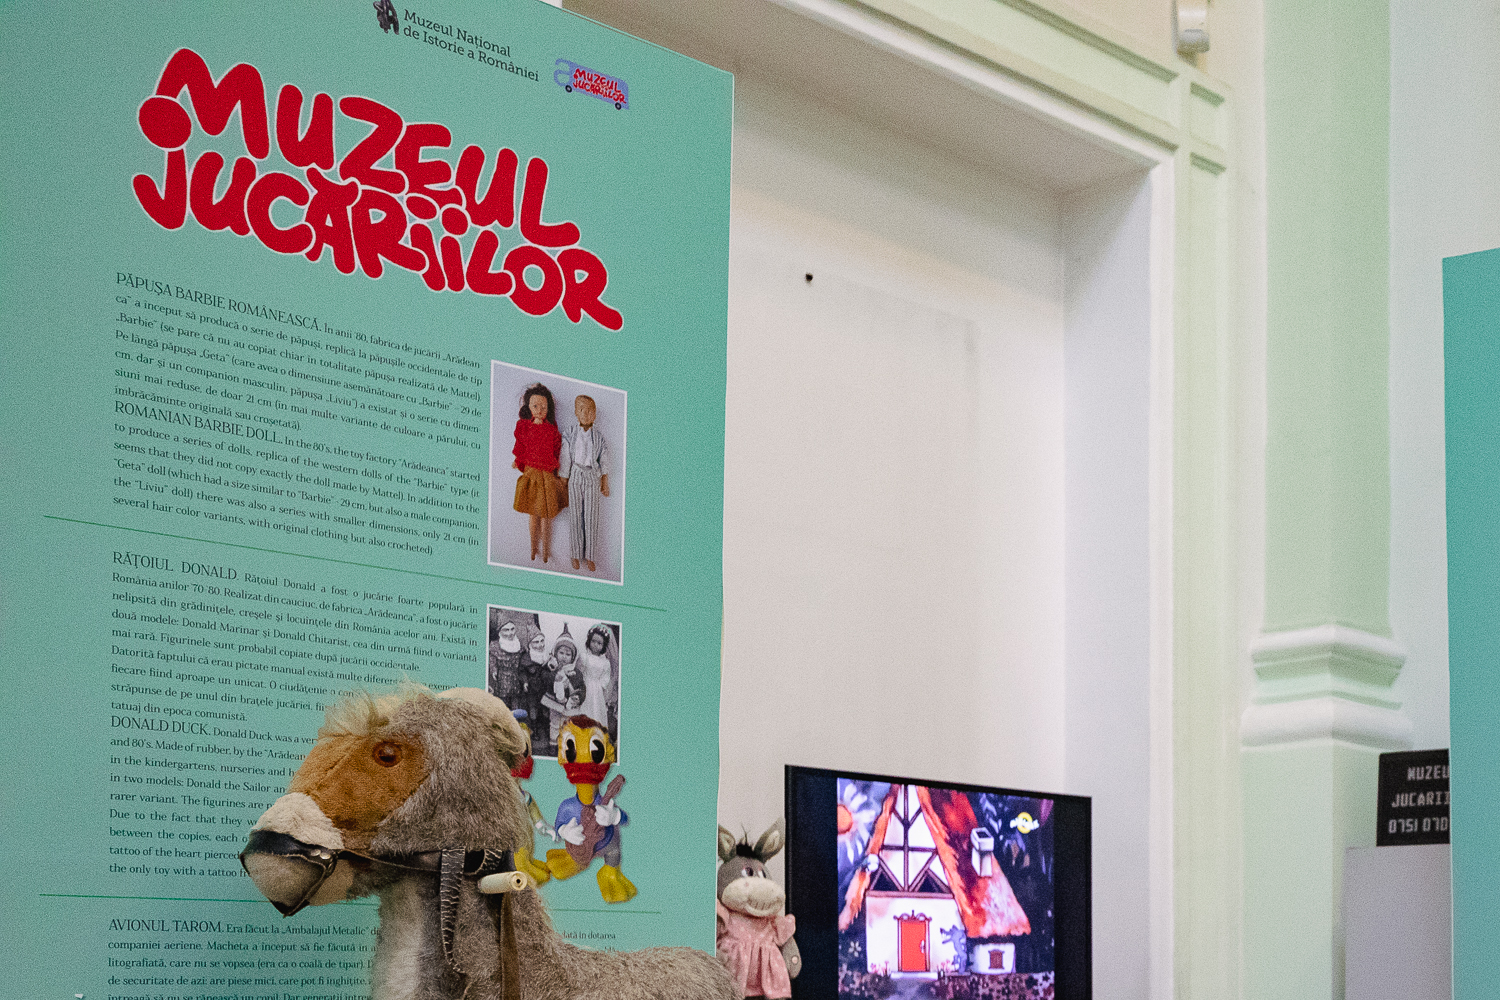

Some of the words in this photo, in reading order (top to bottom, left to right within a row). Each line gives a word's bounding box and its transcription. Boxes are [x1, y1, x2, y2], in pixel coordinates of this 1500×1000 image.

[404, 9, 453, 37] Muzeul
[457, 28, 511, 57] Național
[403, 26, 420, 40] de
[423, 31, 465, 56] Istorie
[467, 51, 476, 60] a
[478, 51, 540, 82] României
[155, 48, 582, 249] MUZEUL
[174, 285, 225, 309] BARBIE
[334, 329, 352, 339] anii
[369, 334, 400, 350] fabrica
[188, 402, 232, 417] originală
[114, 399, 191, 426] ROMANIAN
[194, 415, 244, 437] BARBIE
[245, 425, 283, 444] DOLL.
[365, 451, 397, 468] factory
[449, 469, 481, 482] started
[112, 496, 149, 509] several
[151, 500, 173, 513] hair
[175, 505, 201, 517] color
[247, 518, 270, 529] with
[272, 522, 308, 535] original
[310, 526, 348, 544] clothing
[367, 536, 386, 547] also
[283, 577, 316, 591] Donald
[330, 584, 348, 596] fost
[362, 590, 393, 602] jucărie
[397, 594, 424, 606] foarte
[428, 601, 465, 612] populară
[160, 632, 211, 647] Figurinele
[213, 641, 234, 650] sunt
[237, 643, 277, 655] probabil
[278, 649, 313, 659] copiate
[110, 714, 169, 732] DONALD
[171, 720, 211, 736] DUCK.
[213, 726, 247, 739] Donald
[248, 729, 273, 741] Duck
[108, 846, 141, 856] tattoo
[174, 847, 201, 858] heart
[203, 849, 239, 860] pierced
[128, 863, 151, 876] only
[172, 865, 196, 876] with
[207, 868, 237, 877] tattoo
[108, 918, 170, 932] AVIONUL
[171, 919, 224, 933] TAROM.
[244, 923, 269, 934] făcut
